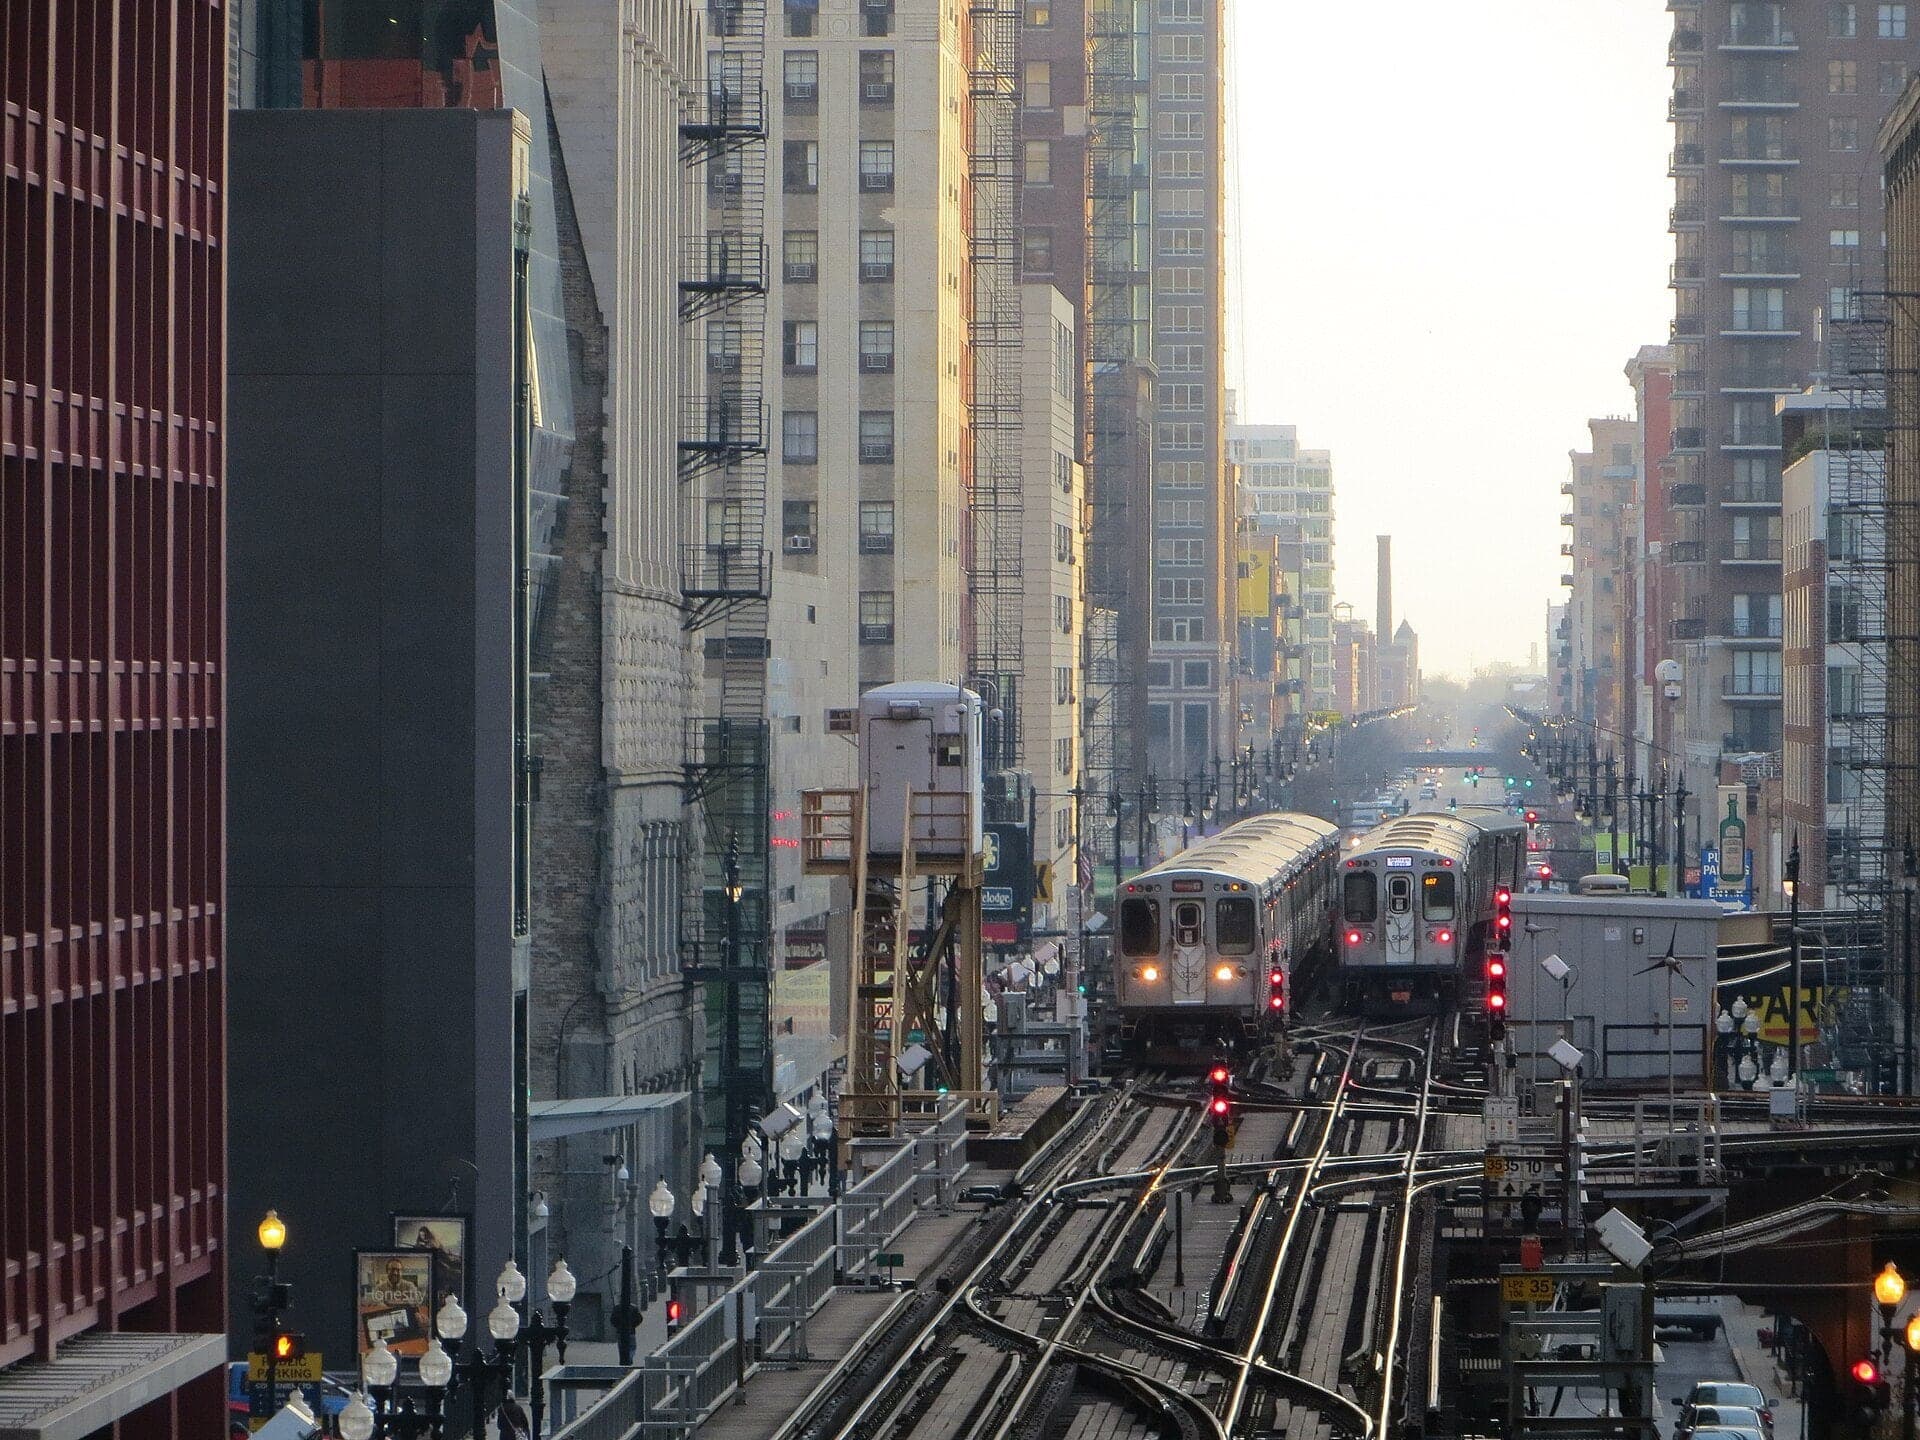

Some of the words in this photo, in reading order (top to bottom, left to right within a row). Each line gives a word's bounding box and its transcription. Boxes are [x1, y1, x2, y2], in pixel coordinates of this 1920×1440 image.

[1487, 1160, 1503, 1171] 35
[1526, 1160, 1542, 1174] 10
[1530, 1279, 1550, 1293] 35
[364, 1287, 424, 1304] Honesty
[261, 1356, 307, 1367] PBLIC
